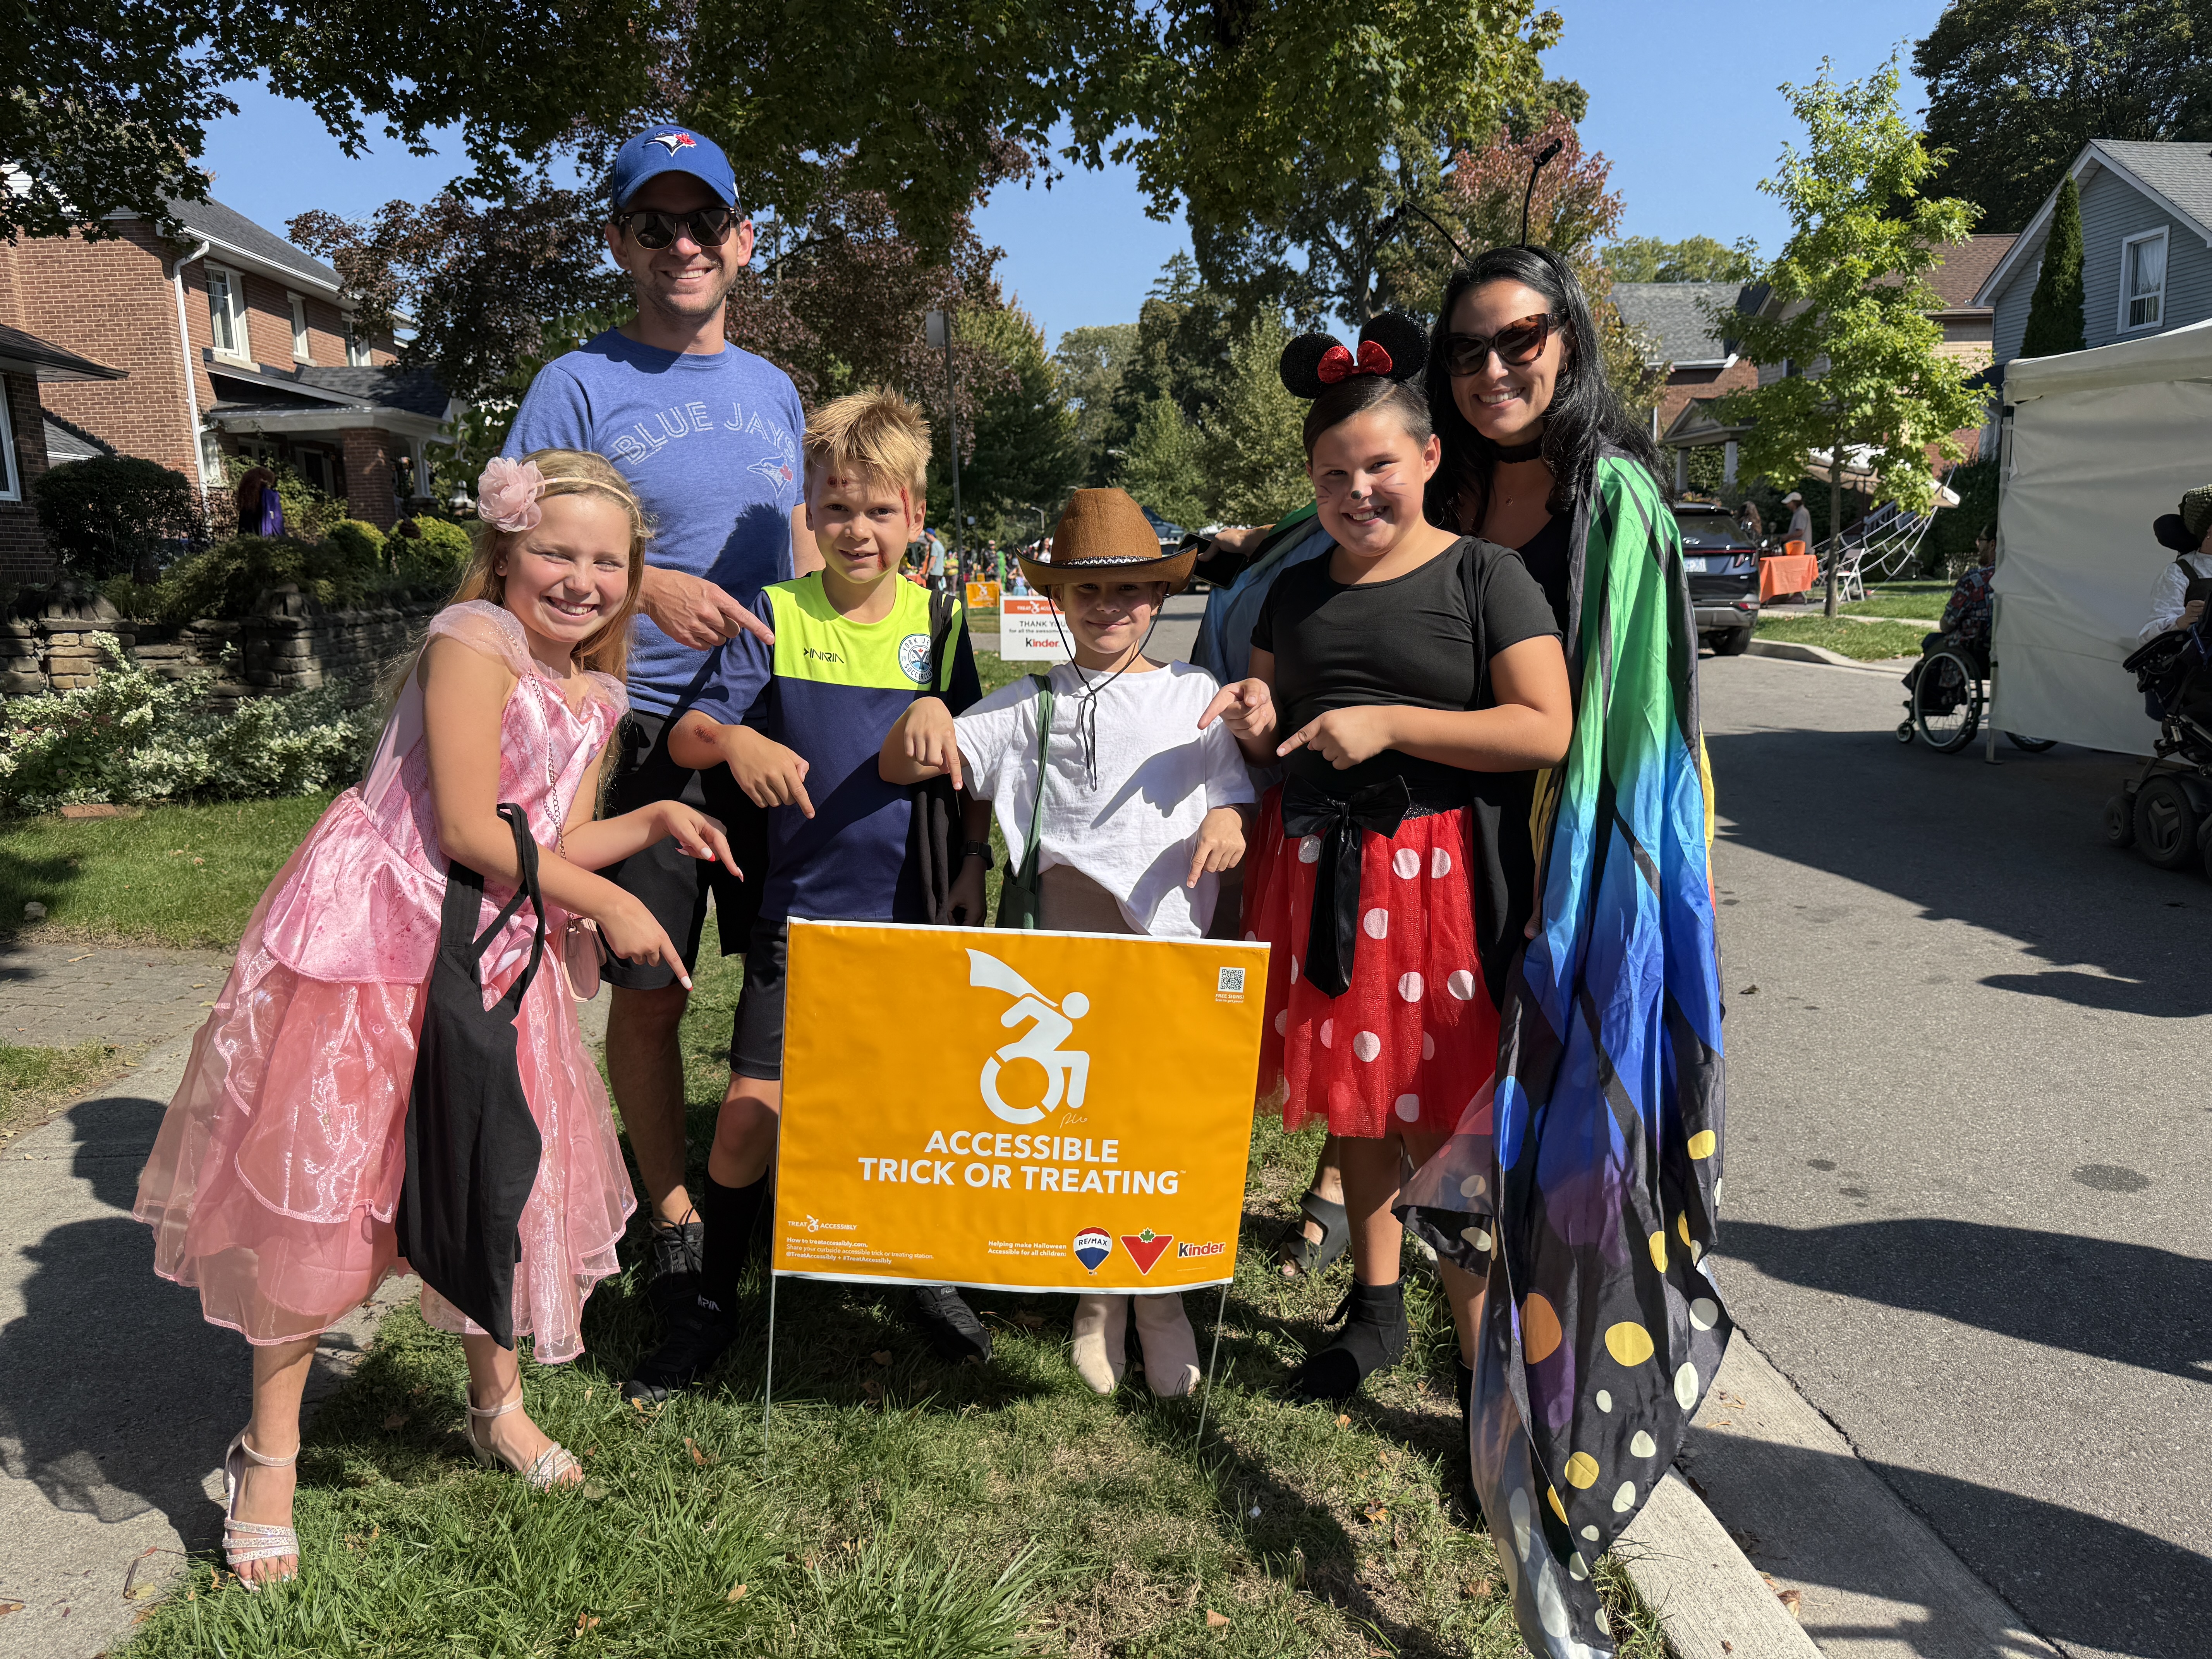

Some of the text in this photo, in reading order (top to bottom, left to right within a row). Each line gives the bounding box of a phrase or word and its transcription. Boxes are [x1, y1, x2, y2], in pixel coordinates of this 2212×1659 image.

[611, 401, 795, 465] BLUE JAYS
[902, 638, 918, 651] YORK
[904, 664, 924, 680] SOCCER
[924, 1130, 1119, 1163] ACCESSIBLE
[858, 1158, 955, 1185] TRICK
[963, 1162, 1012, 1189] OR
[1078, 1238, 1108, 1247] RE/MAX
[786, 1251, 836, 1261] @TreatAccessibly
[843, 1255, 892, 1264] #TreatAccessibly
